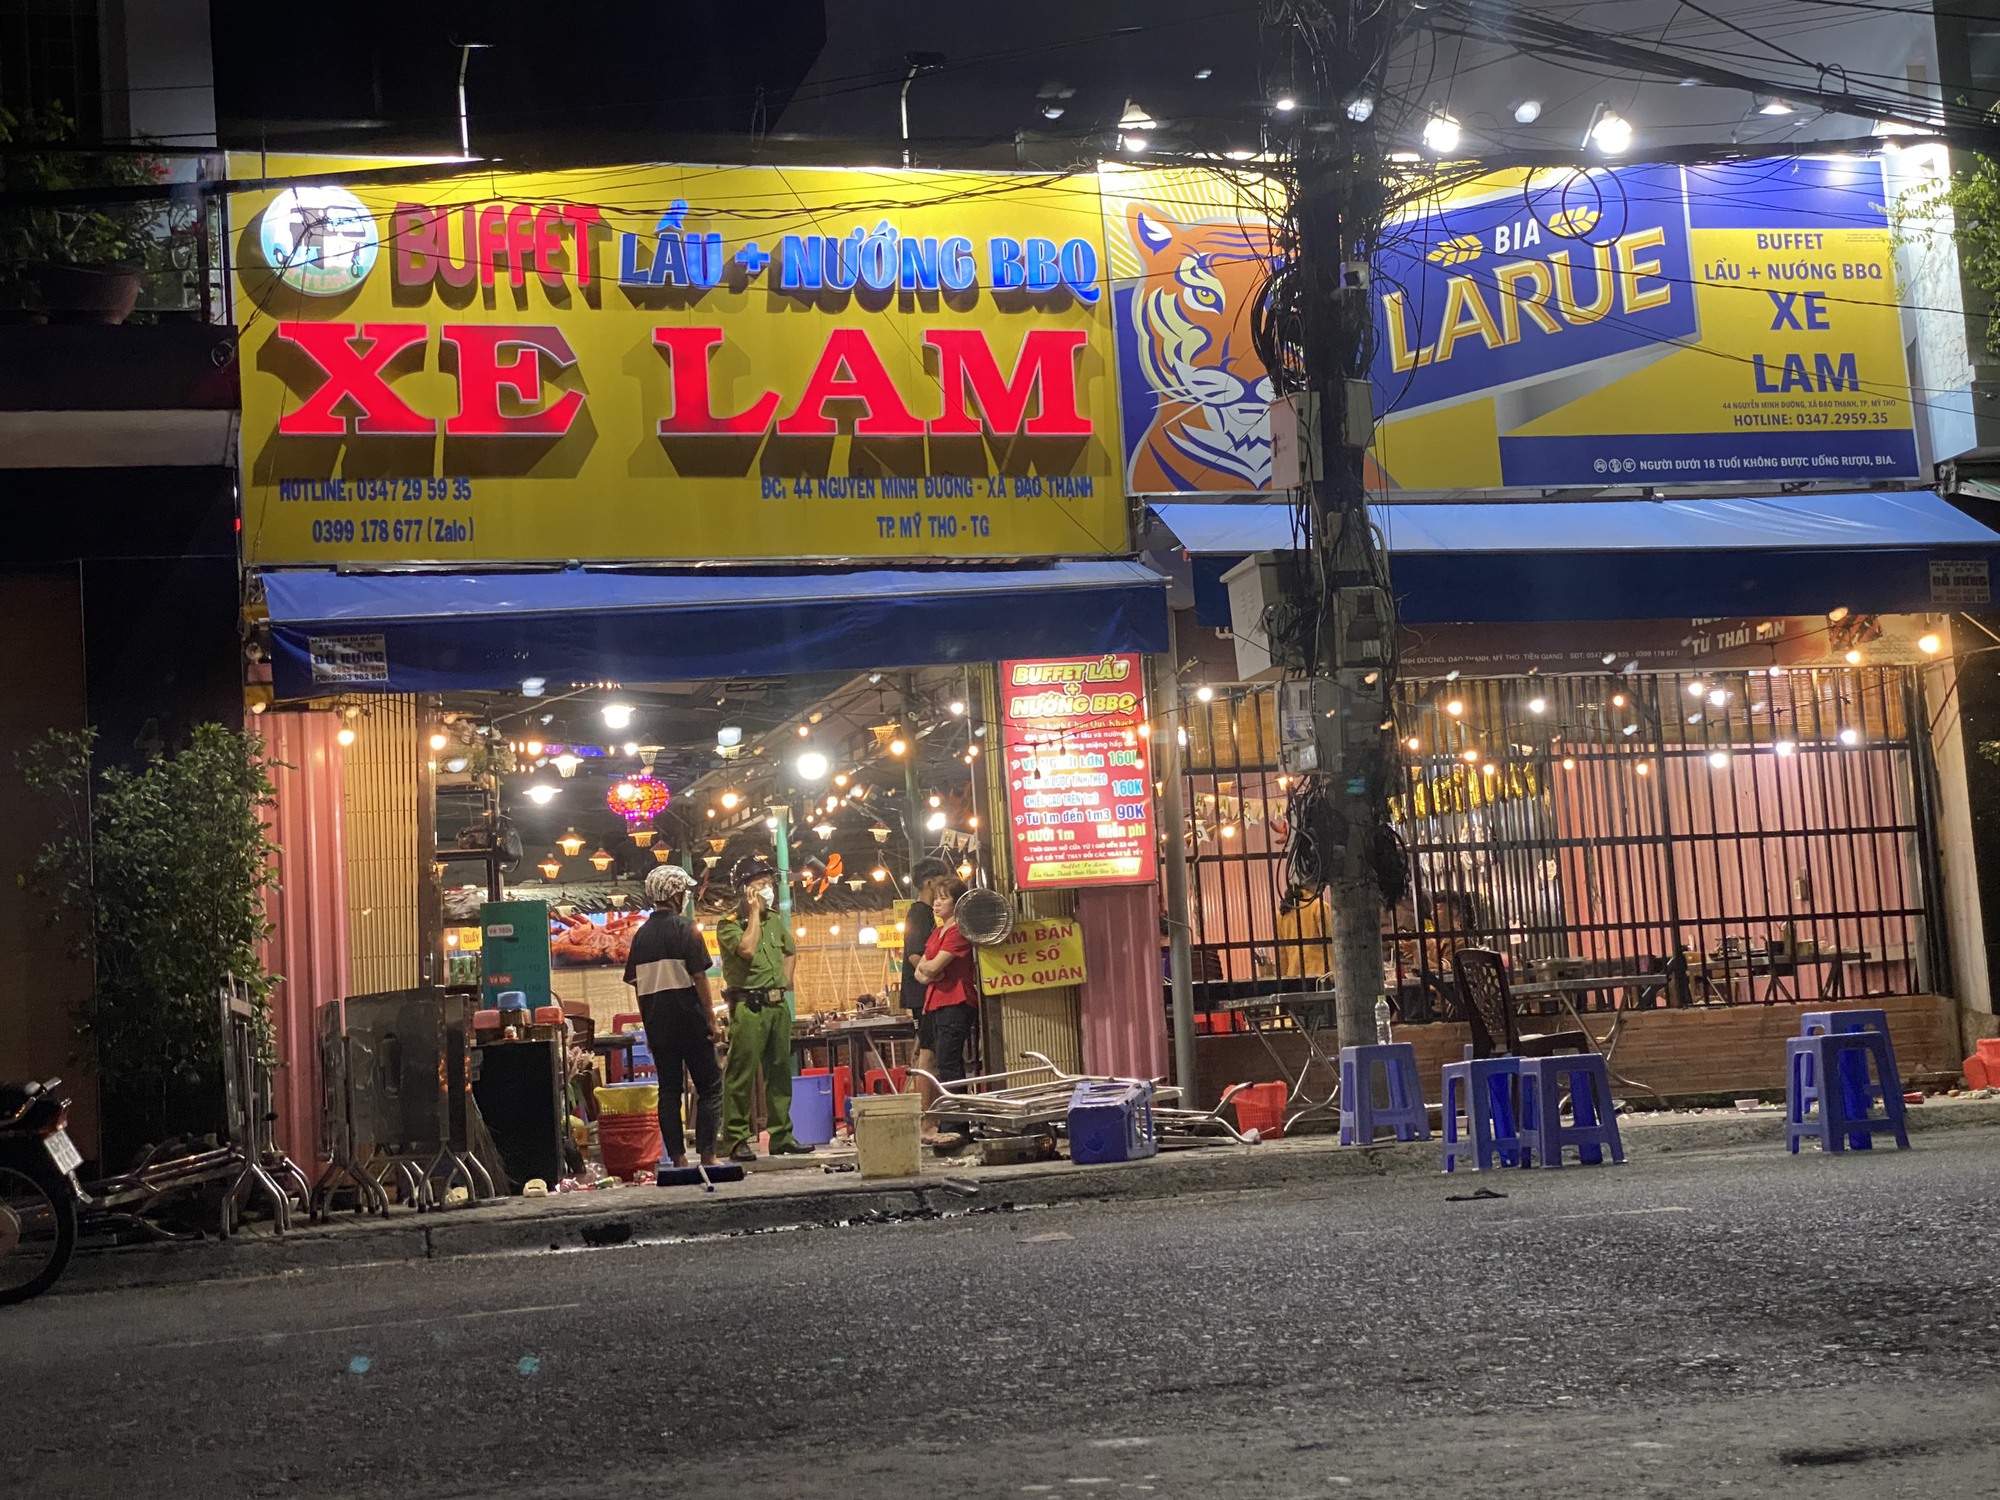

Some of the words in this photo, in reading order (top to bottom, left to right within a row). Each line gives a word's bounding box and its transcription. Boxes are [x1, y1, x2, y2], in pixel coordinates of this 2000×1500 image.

[1495, 218, 1541, 255] BIA
[1757, 233, 1824, 250] BUFFET
[393, 202, 600, 288] BUFFET
[618, 199, 723, 288] LẨU
[781, 220, 976, 291] NƯỚNG
[989, 237, 1100, 303] BBQ
[1704, 257, 1741, 280] LẨU
[1767, 259, 1837, 280] NƯỚNG
[1842, 263, 1882, 280] BBQ
[1382, 226, 1671, 373] LARUE
[1766, 290, 1831, 330] XE
[277, 322, 586, 436] XE
[652, 326, 1094, 436] LAM
[1753, 353, 1860, 393] LAM
[1761, 401, 1779, 409] MINH
[1883, 399, 1896, 407] THO
[1734, 413, 1793, 426] HOTLINE:
[1796, 412, 1888, 425] 0347.2959.35
[1640, 460, 1673, 470] NGƯỜI
[1675, 458, 1701, 469] DƯỚI
[1703, 459, 1716, 469] 18
[1717, 455, 1741, 469] TUỔI
[1743, 456, 1778, 467] KHÔNG
[1780, 456, 1809, 468] ĐƯỢC
[1811, 454, 1839, 466] UỐNG
[1841, 455, 1873, 467] RƯỢU,
[1875, 455, 1896, 465] BIA.
[427, 477, 448, 501] 59
[452, 477, 472, 501] 35
[793, 477, 812, 499] 44
[818, 468, 875, 499] NGUYỄN
[881, 476, 918, 499] MINH
[1014, 477, 1042, 502] ĐẠO
[1046, 475, 1094, 502] THẠNH
[312, 519, 355, 543] 0399
[360, 519, 390, 543] 178
[393, 519, 423, 543] 677
[427, 516, 474, 543] (Zalo)
[900, 511, 922, 538] MỸ
[928, 515, 957, 538] THO
[970, 515, 990, 537] TG
[1692, 630, 1711, 655] TỪ
[1717, 621, 1750, 649] THÁI
[1014, 663, 1086, 684] BUFFET
[1087, 655, 1129, 683] LẨU
[1012, 691, 1089, 717] NƯỚNG
[1093, 694, 1136, 714] BBQ
[1094, 731, 1102, 739] và
[1112, 780, 1144, 796] 160K
[1043, 812, 1060, 824] 1m
[1063, 808, 1083, 823] đến
[1086, 809, 1110, 822] 1m3
[1117, 804, 1145, 820] 90K
[1057, 829, 1075, 841] 1m
[1128, 822, 1146, 838] phí
[1067, 852, 1082, 860] THAY
[1034, 924, 1073, 942] BÁN
[1005, 949, 1028, 966] VÉ
[1036, 942, 1060, 962] SỐ
[988, 970, 1025, 989] VÀO
[1031, 965, 1083, 985] QUÁN
